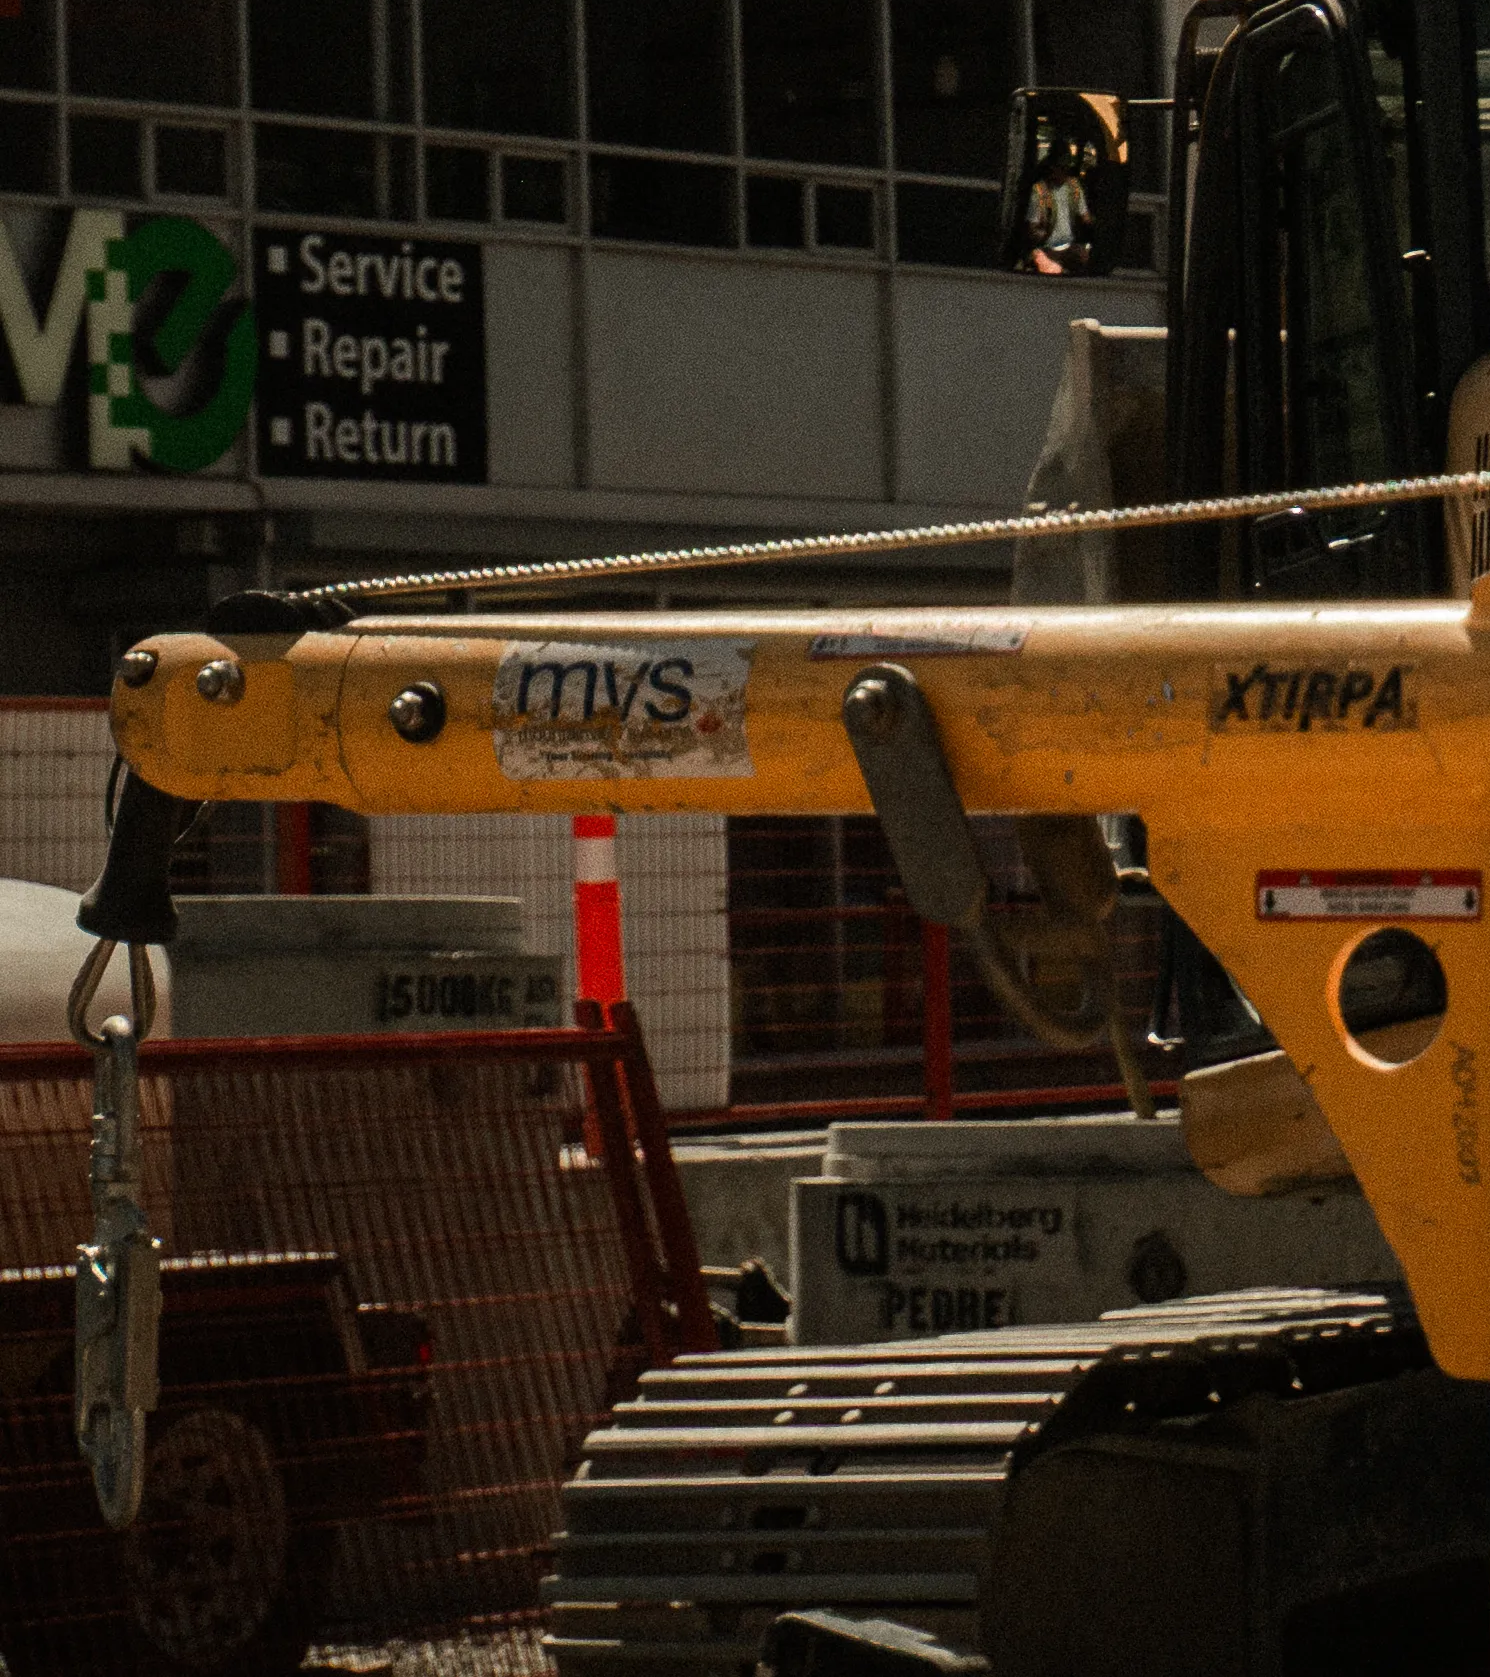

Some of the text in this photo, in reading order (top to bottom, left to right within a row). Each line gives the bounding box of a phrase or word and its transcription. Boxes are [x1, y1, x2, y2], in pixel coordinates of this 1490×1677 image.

[299, 233, 465, 304] Service
[302, 317, 453, 395] Repair
[303, 400, 459, 466] Return
[516, 656, 696, 723] mvs
[1216, 662, 1410, 731] XTIRPA
[897, 1199, 1063, 1235] Heidelberg
[897, 1235, 1040, 1263] Materials
